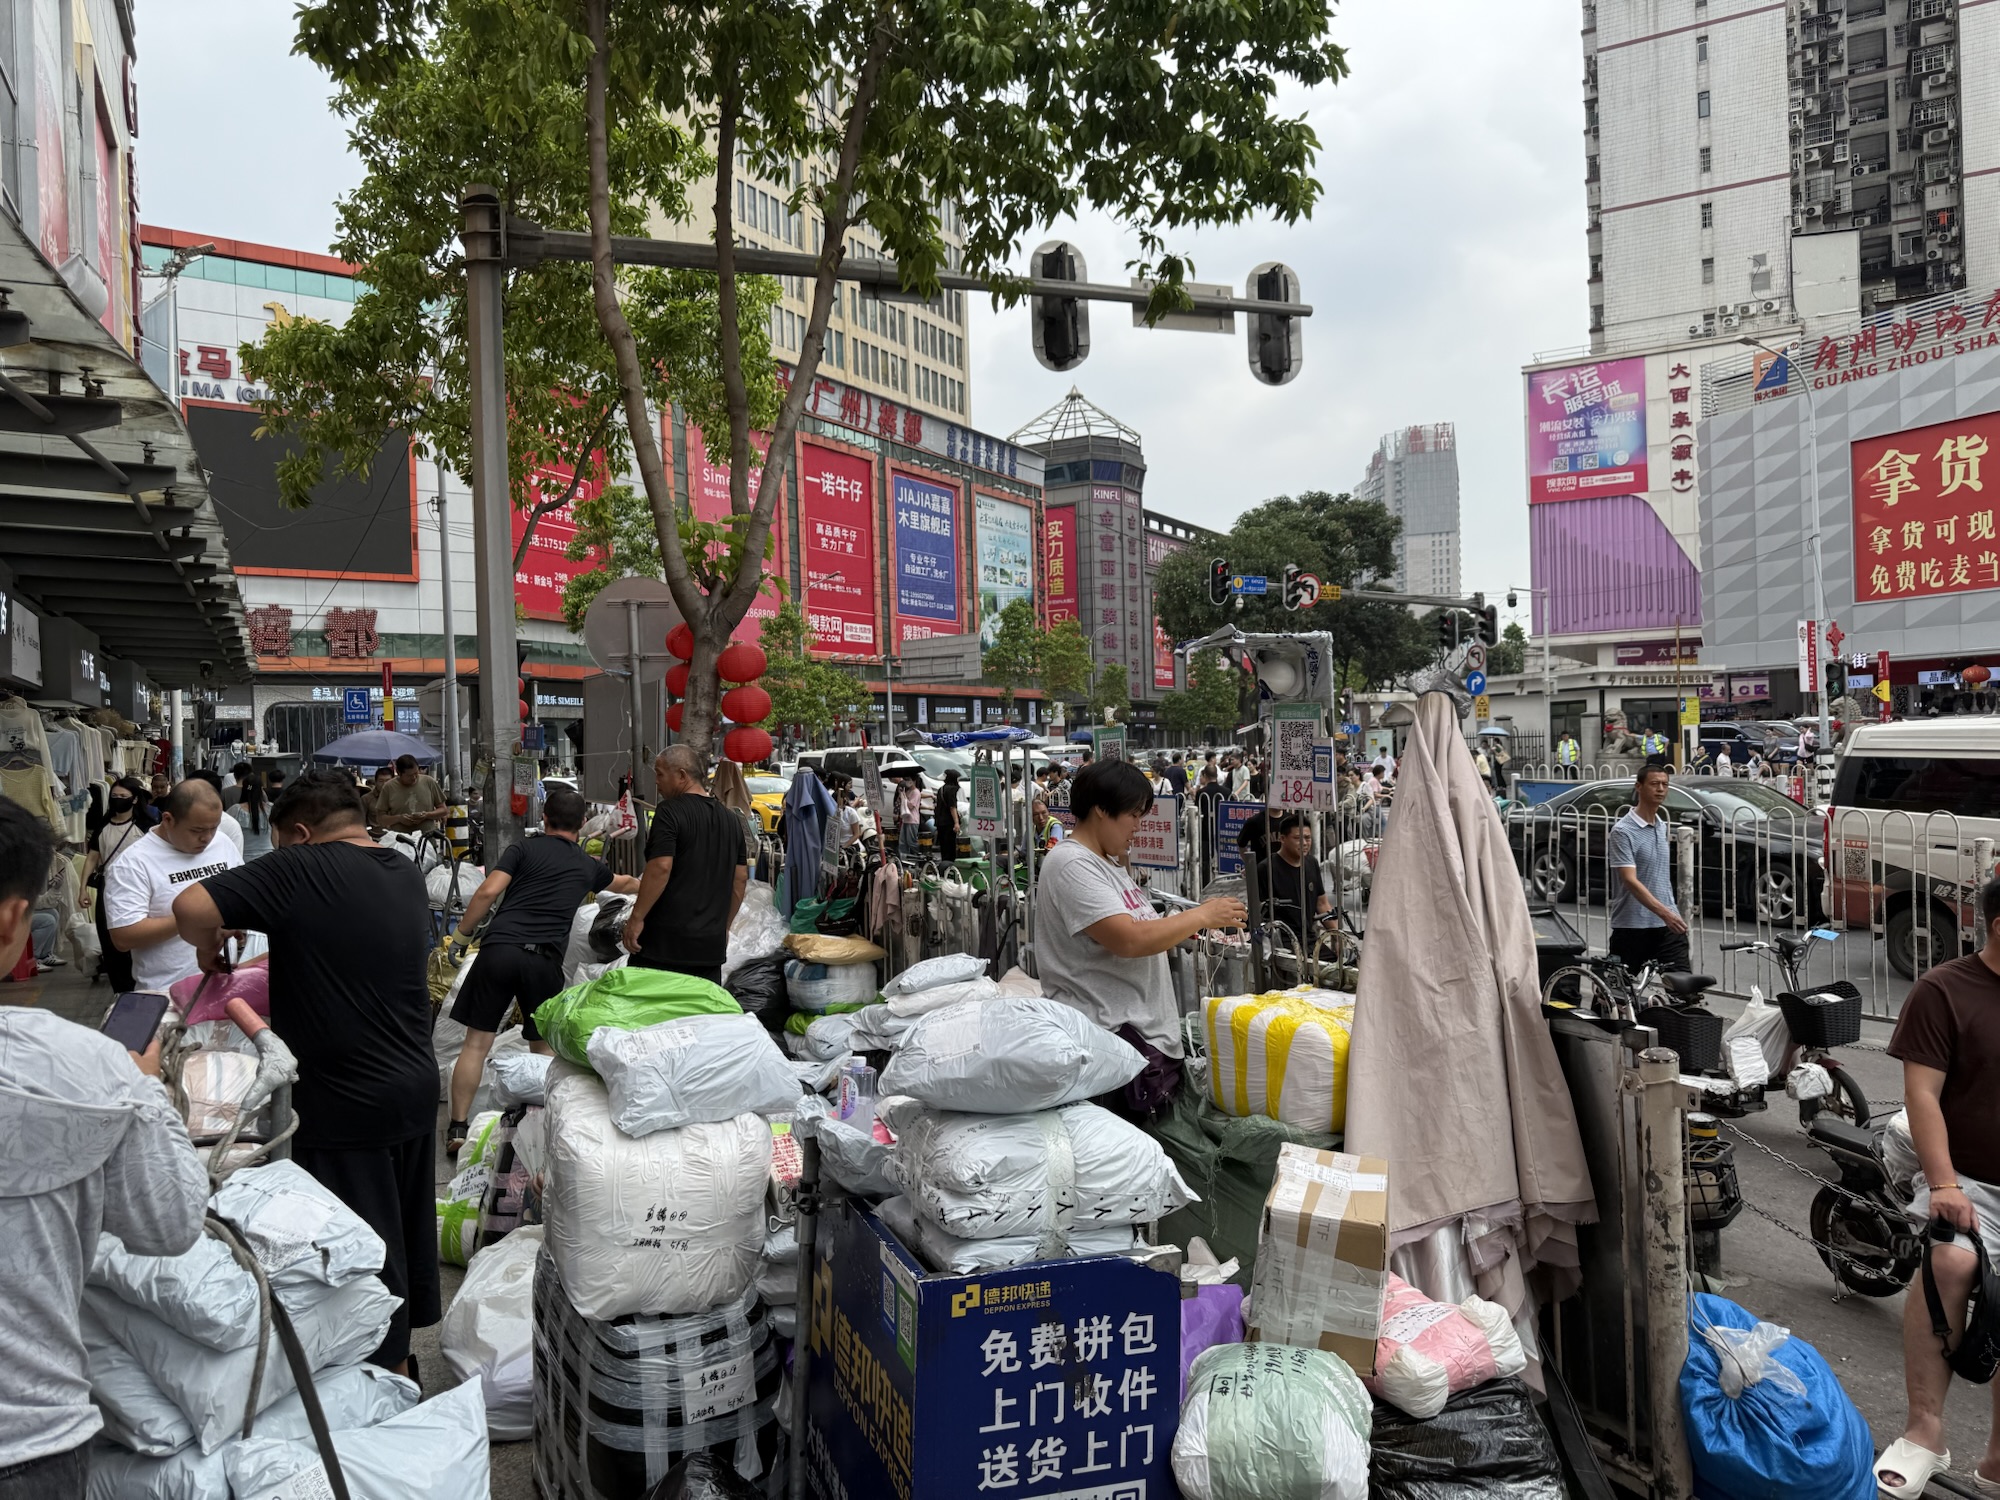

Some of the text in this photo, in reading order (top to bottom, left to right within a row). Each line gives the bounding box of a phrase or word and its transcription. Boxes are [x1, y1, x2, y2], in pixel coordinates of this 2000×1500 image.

[1813, 332, 2000, 391] GUANG ZHOU SHA
[805, 471, 863, 502] 一诺牛仔
[1868, 434, 1988, 506] 拿货
[898, 509, 951, 538] 木里旗舰店
[1048, 520, 1064, 596] 实力质造
[1281, 780, 1314, 803] 184
[977, 818, 995, 832] 325
[983, 1280, 1052, 1305] 德邦快递
[984, 1299, 1051, 1315] DEPPON EXPRESS
[980, 1311, 1158, 1377] 免费拼包
[979, 1365, 1158, 1434] 上门收件
[977, 1424, 1155, 1492] 送货上门
